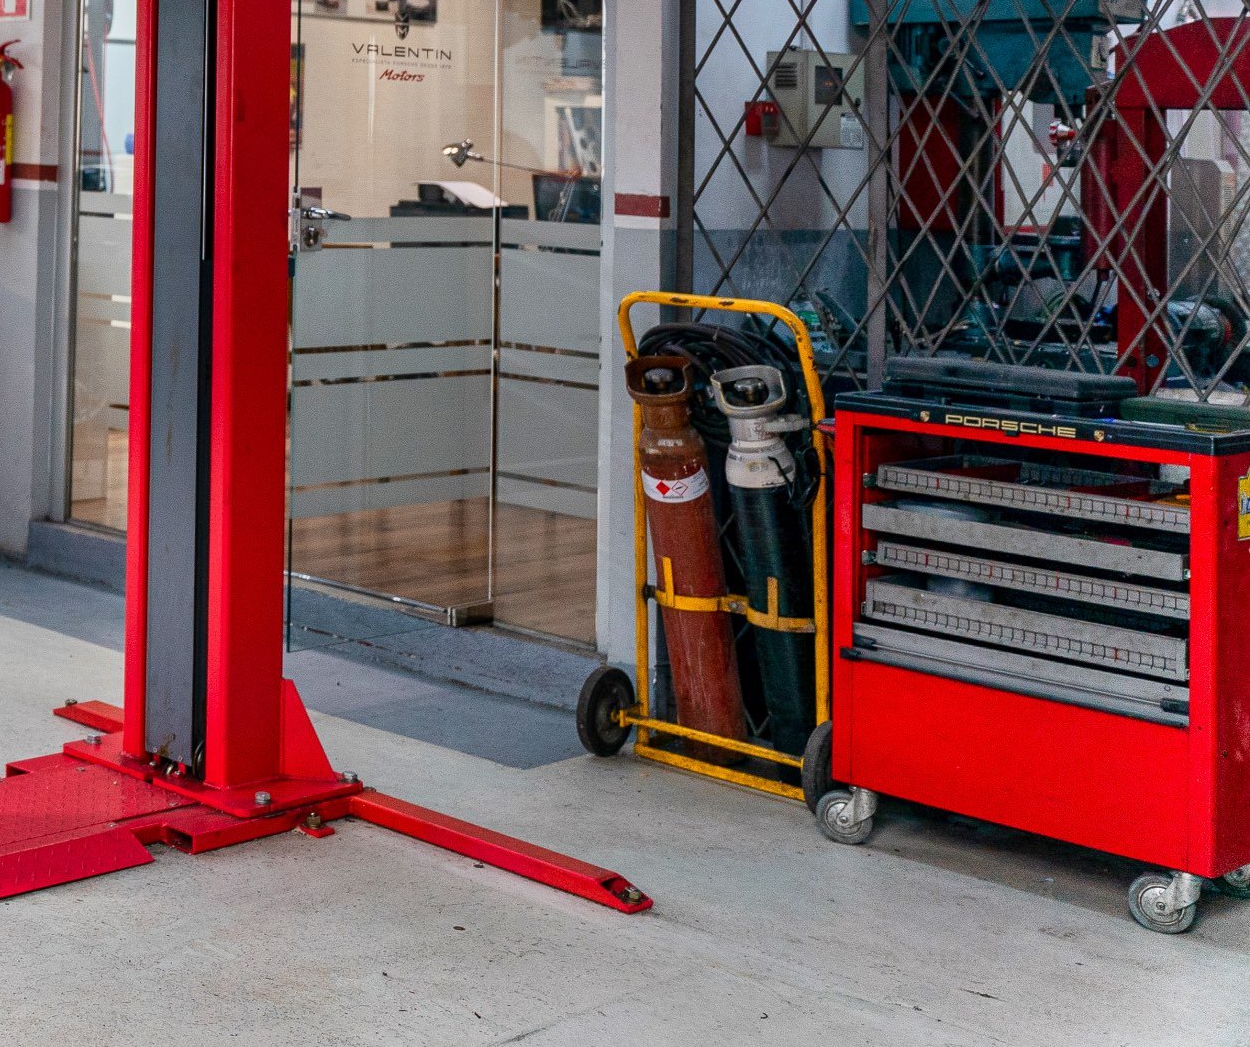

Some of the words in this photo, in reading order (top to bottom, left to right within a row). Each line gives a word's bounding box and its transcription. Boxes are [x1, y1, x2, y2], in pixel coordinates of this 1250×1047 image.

[352, 43, 452, 61] VALENTIN
[379, 68, 425, 82] Motors
[945, 414, 1077, 439] PORSCHE
